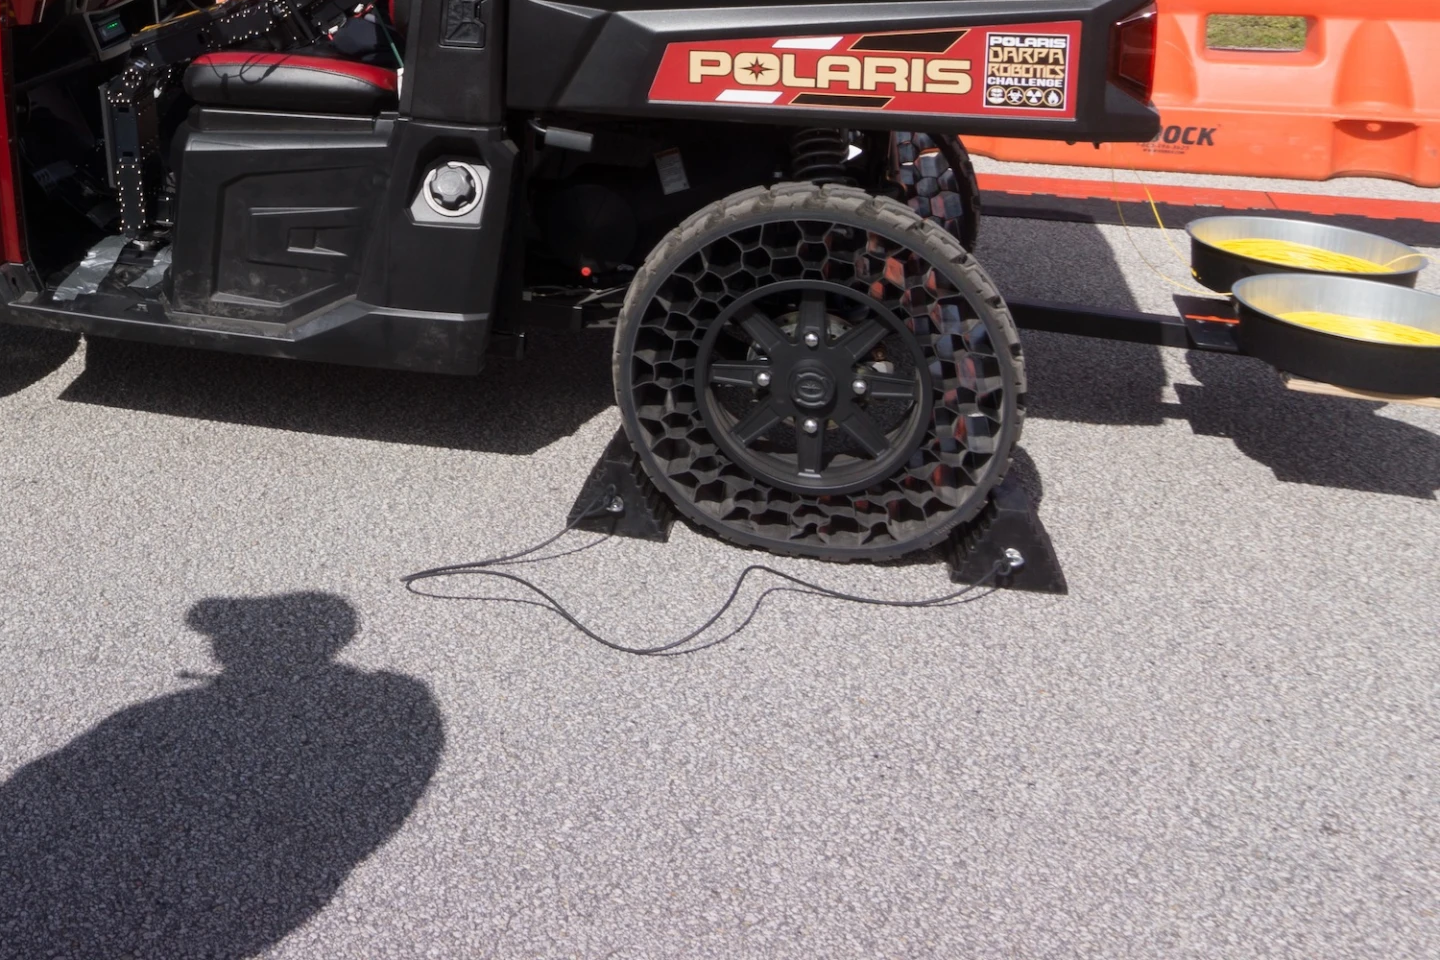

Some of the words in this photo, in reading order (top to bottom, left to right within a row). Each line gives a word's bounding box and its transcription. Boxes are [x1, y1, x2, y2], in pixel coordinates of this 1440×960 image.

[990, 36, 1066, 48] POLARIS
[989, 46, 1064, 64] DARPA
[688, 50, 972, 94] POLARIS
[988, 63, 1065, 79] ROBOTICS
[987, 77, 1063, 87] CHALLENGE
[1156, 125, 1217, 146] OCK
